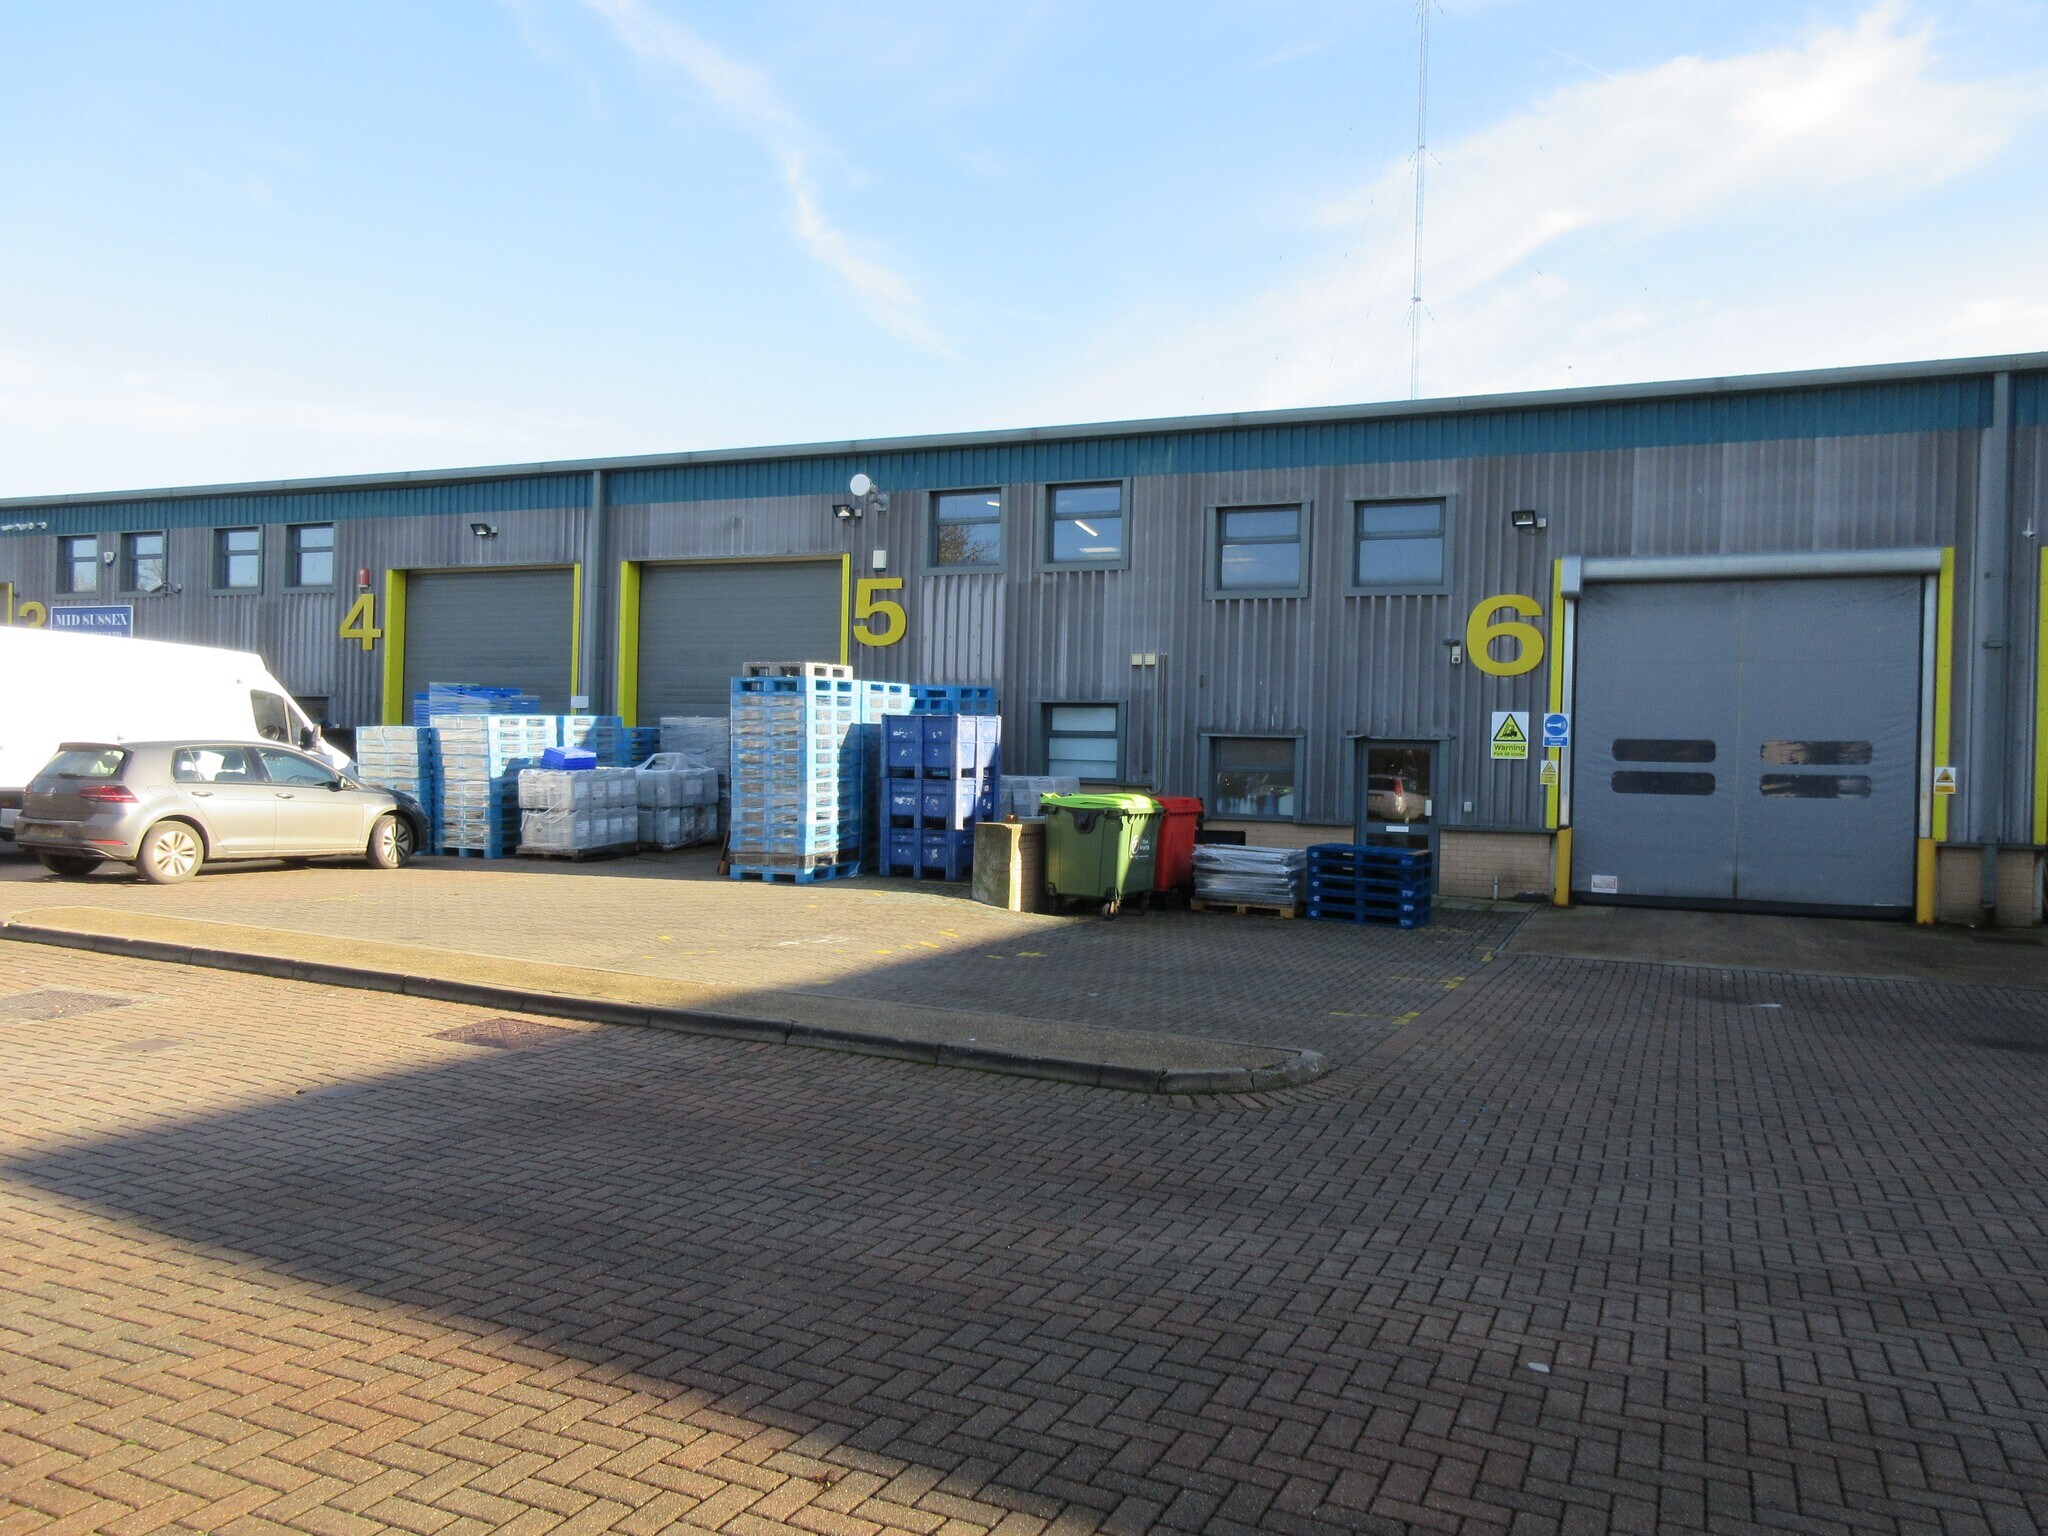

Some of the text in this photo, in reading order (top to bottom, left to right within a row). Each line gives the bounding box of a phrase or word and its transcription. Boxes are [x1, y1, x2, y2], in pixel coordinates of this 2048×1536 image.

[56, 613, 128, 626] MID SUSSEX
[340, 593, 382, 650] 4
[852, 577, 907, 648] 5
[1466, 594, 1544, 677] 6
[1493, 744, 1526, 752] Warning
